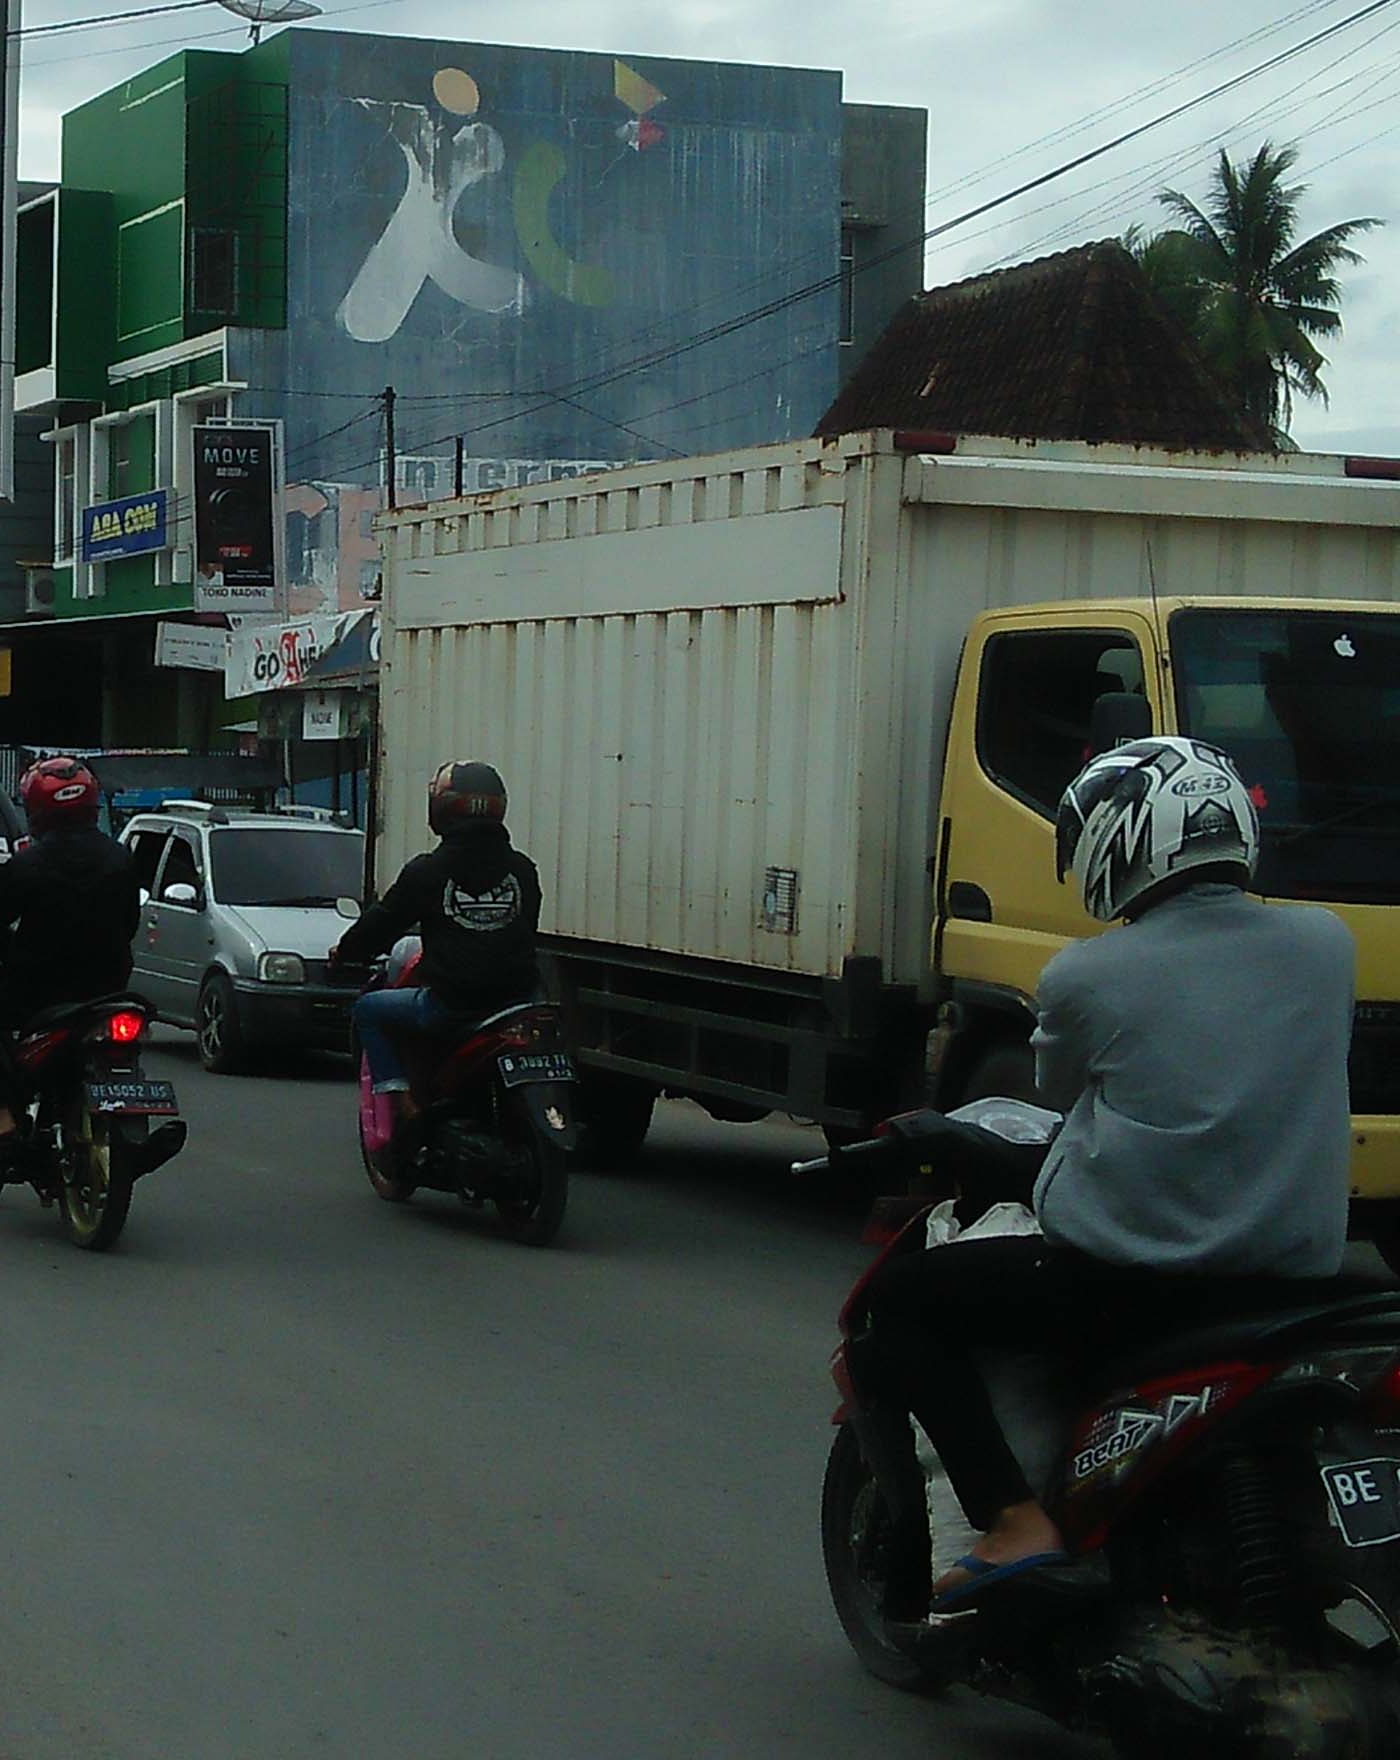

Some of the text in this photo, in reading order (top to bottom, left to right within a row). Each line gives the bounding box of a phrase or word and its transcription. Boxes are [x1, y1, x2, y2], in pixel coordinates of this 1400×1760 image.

[204, 447, 260, 464] MOVE
[254, 651, 281, 681] GO
[1332, 1469, 1382, 1506] BE
